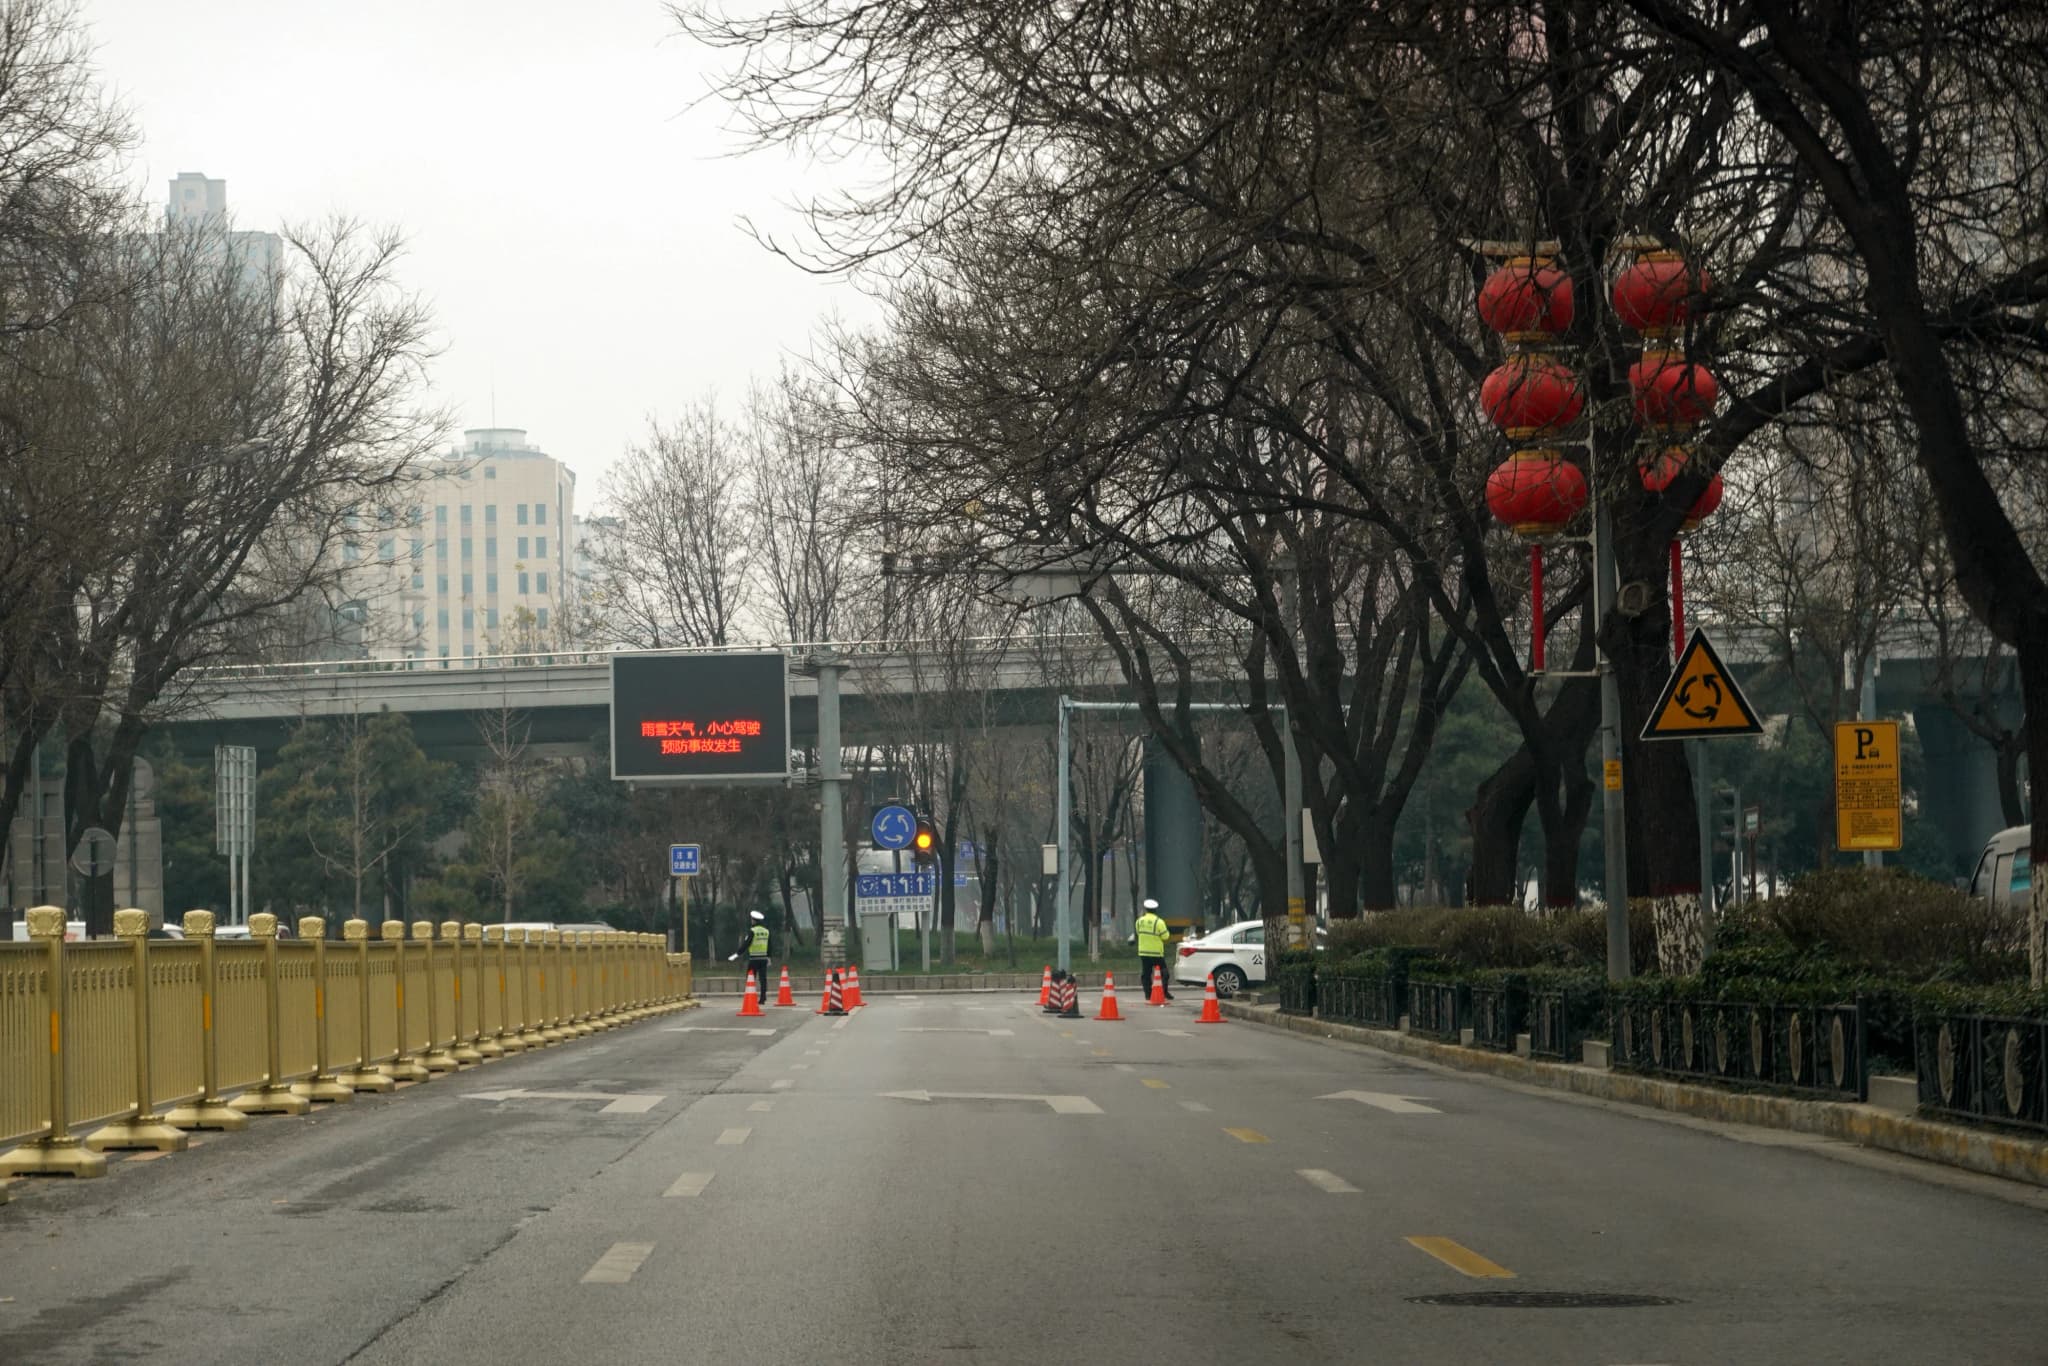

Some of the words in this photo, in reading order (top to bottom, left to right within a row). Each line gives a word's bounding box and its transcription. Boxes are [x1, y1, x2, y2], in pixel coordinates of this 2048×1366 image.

[641, 721, 761, 736] 雨雪天气，小心驾驶
[661, 739, 741, 754] 预防事故发生
[1854, 728, 1874, 760] P
[1251, 953, 1264, 966] 公
